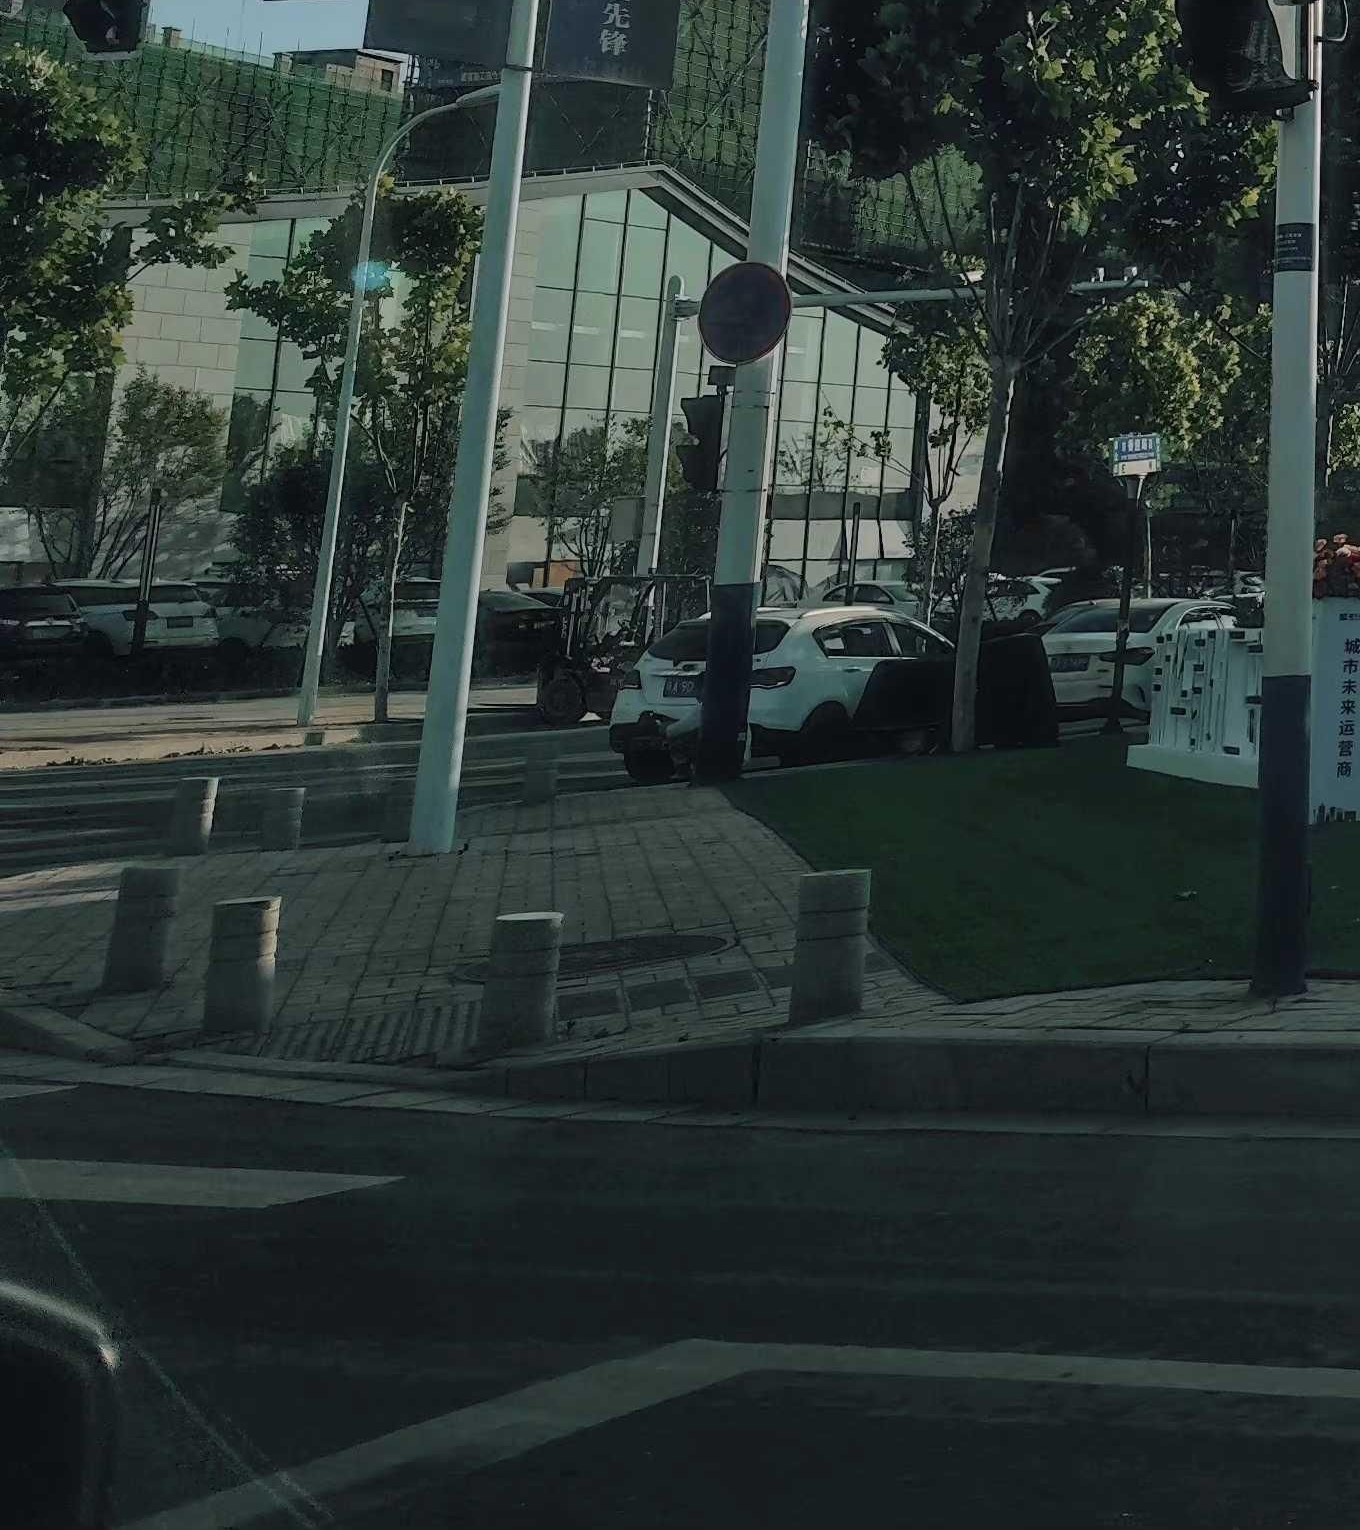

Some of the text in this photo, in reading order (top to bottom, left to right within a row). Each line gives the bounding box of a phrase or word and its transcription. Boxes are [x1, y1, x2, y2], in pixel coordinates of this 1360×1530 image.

[1337, 638, 1360, 778] 城市未来运营商
